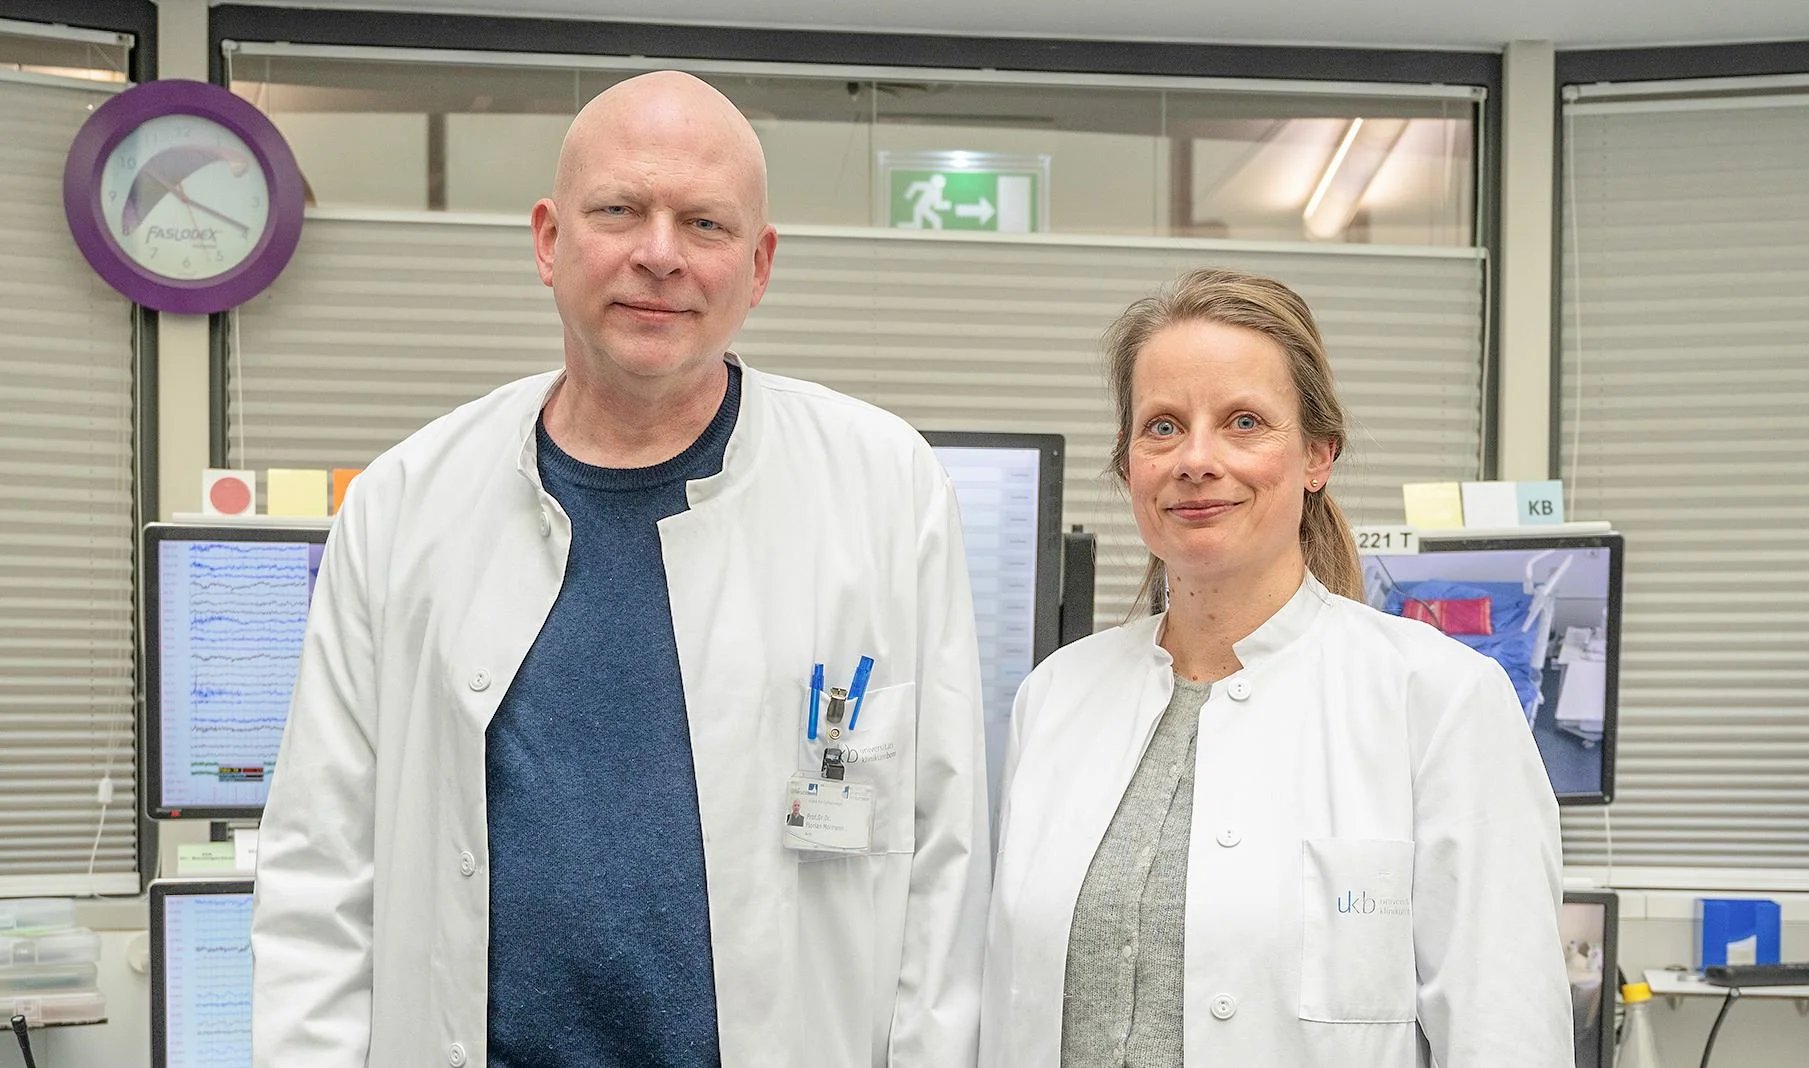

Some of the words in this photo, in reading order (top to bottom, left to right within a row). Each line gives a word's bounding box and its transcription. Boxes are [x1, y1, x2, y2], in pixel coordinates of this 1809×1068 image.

[120, 156, 137, 170] 10
[145, 225, 222, 244] FASLODEX
[150, 246, 159, 259] 7
[215, 250, 224, 262] 5
[182, 256, 191, 269] 6
[1528, 500, 1553, 516] KB
[1359, 533, 1391, 549] 221
[1400, 532, 1412, 548] T
[1338, 890, 1376, 914] ukb
